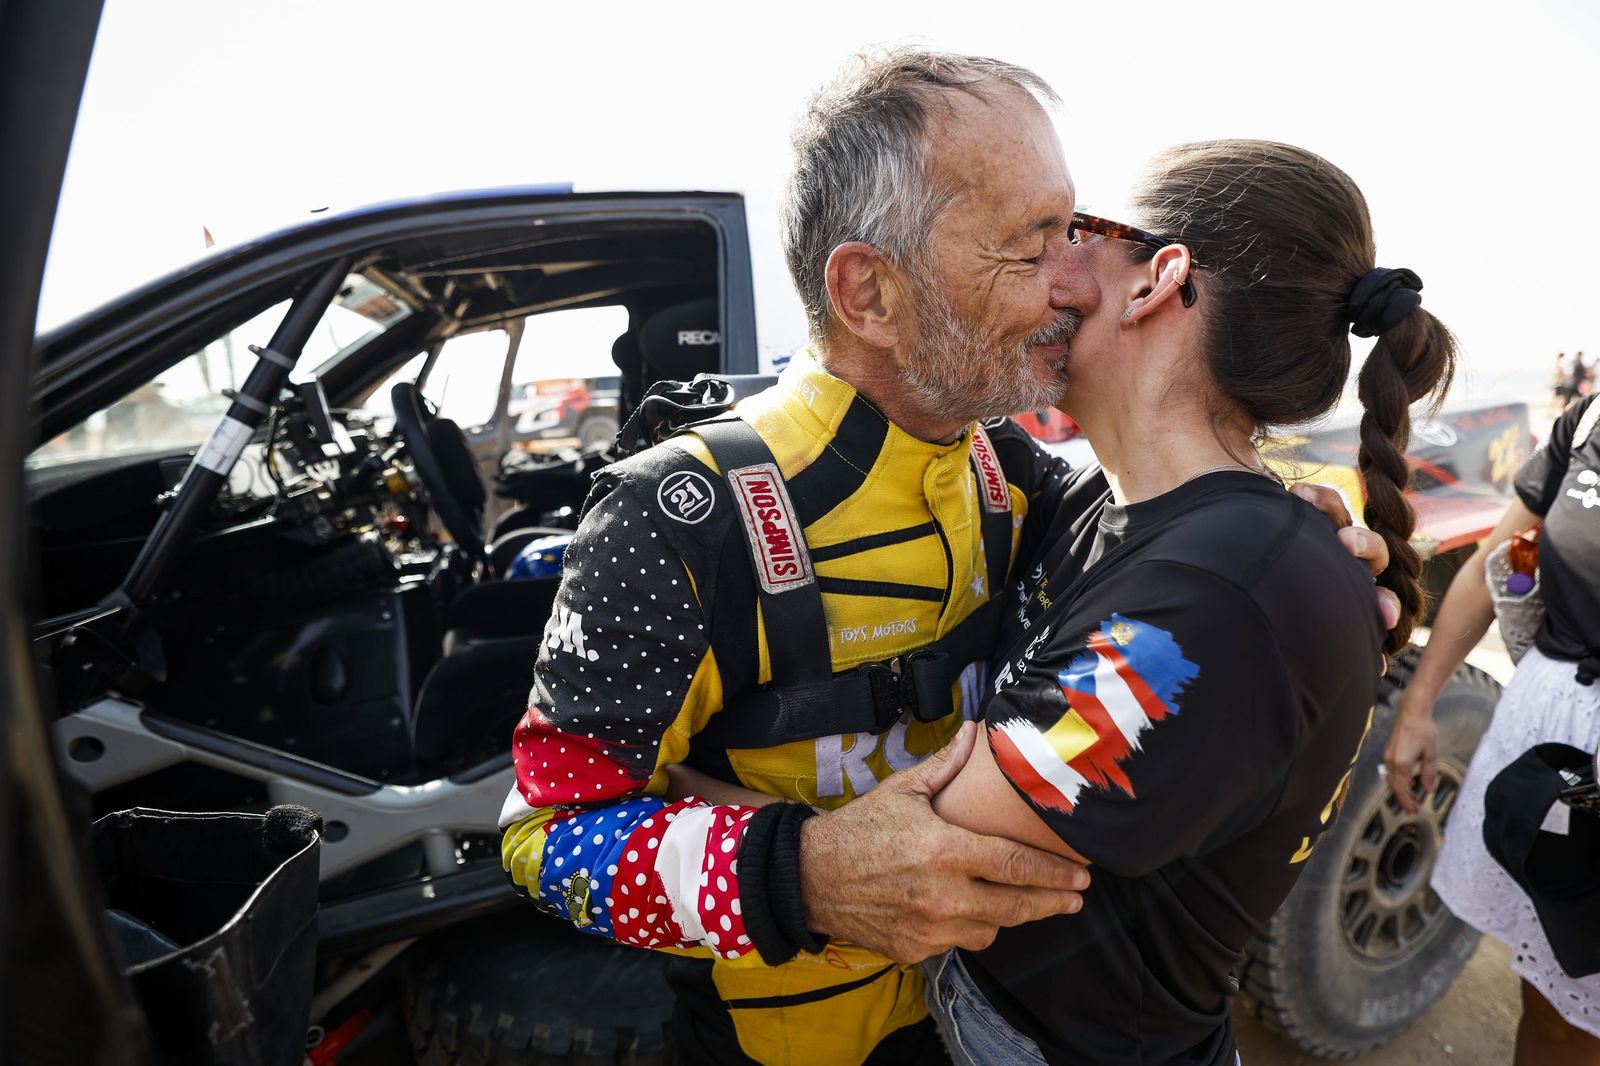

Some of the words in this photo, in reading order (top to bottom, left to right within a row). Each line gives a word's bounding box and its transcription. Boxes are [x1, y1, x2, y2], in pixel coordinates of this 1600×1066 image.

[670, 481, 704, 514] 21
[746, 480, 797, 576] SIMPSON
[836, 625, 867, 644] TOYS
[872, 618, 917, 640] MOTORS
